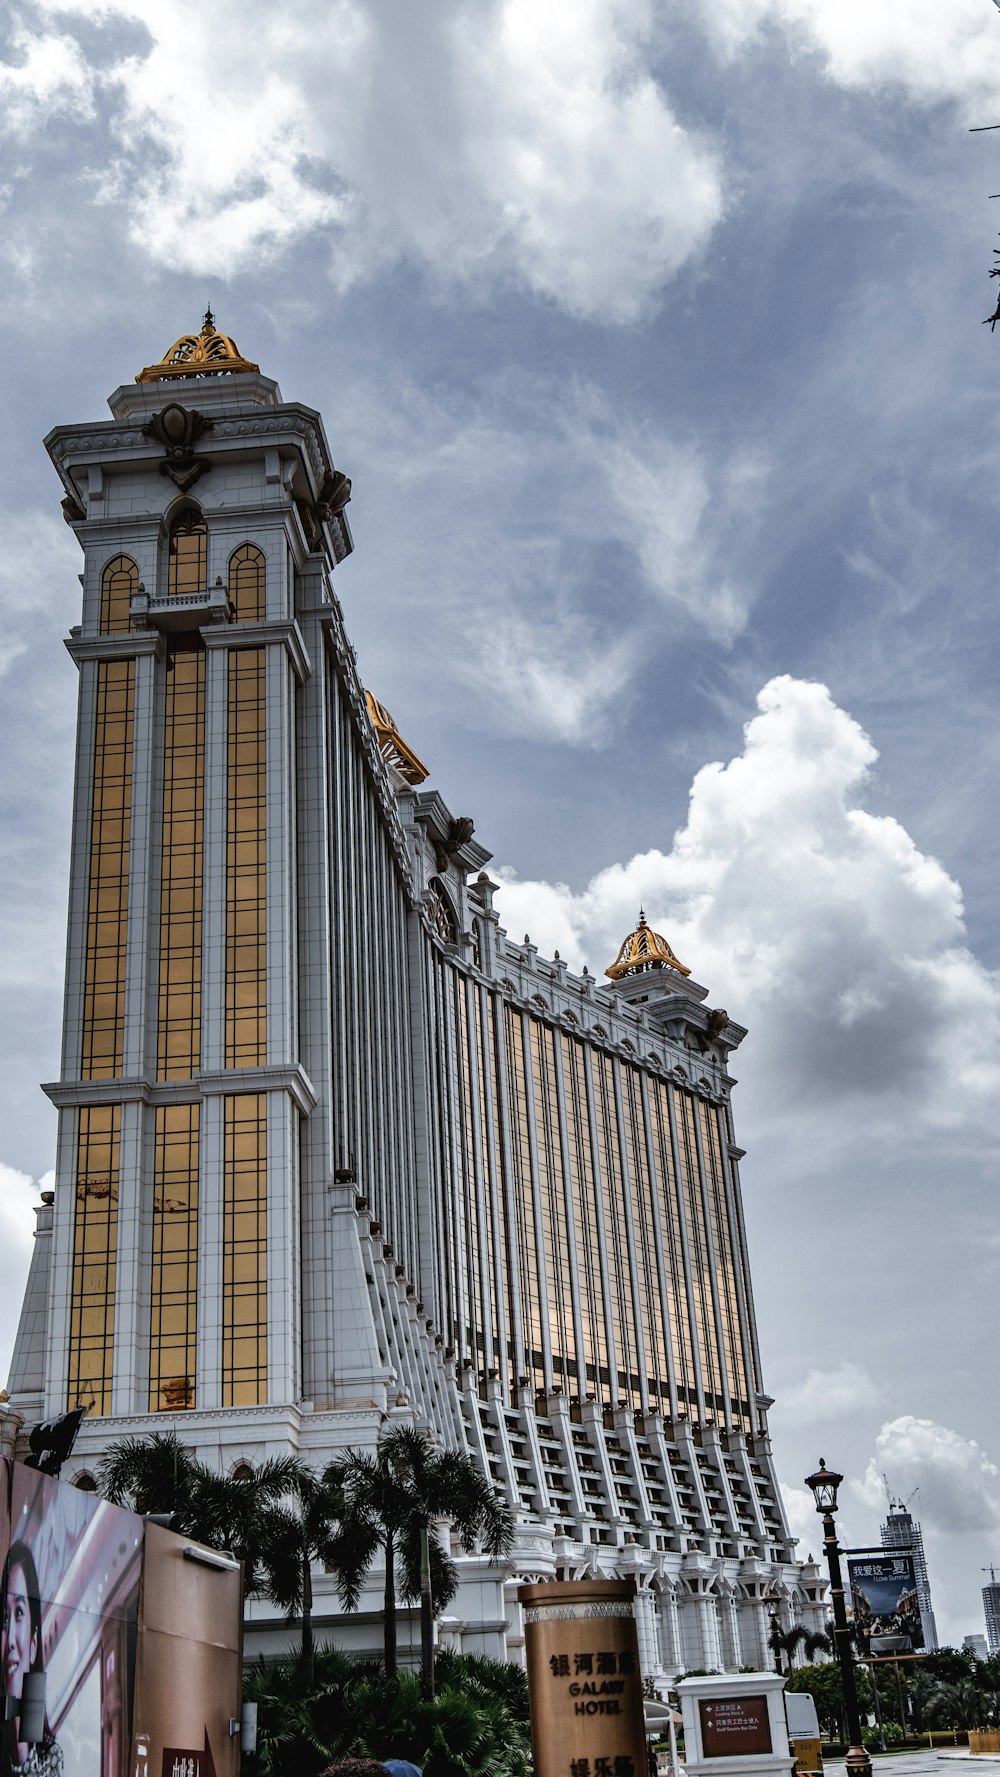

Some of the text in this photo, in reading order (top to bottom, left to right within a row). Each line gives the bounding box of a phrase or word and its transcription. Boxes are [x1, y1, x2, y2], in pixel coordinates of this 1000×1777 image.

[549, 1651, 637, 1677] 银河酒店
[568, 1680, 626, 1697] GALAXY
[574, 1699, 624, 1716] HOTEL
